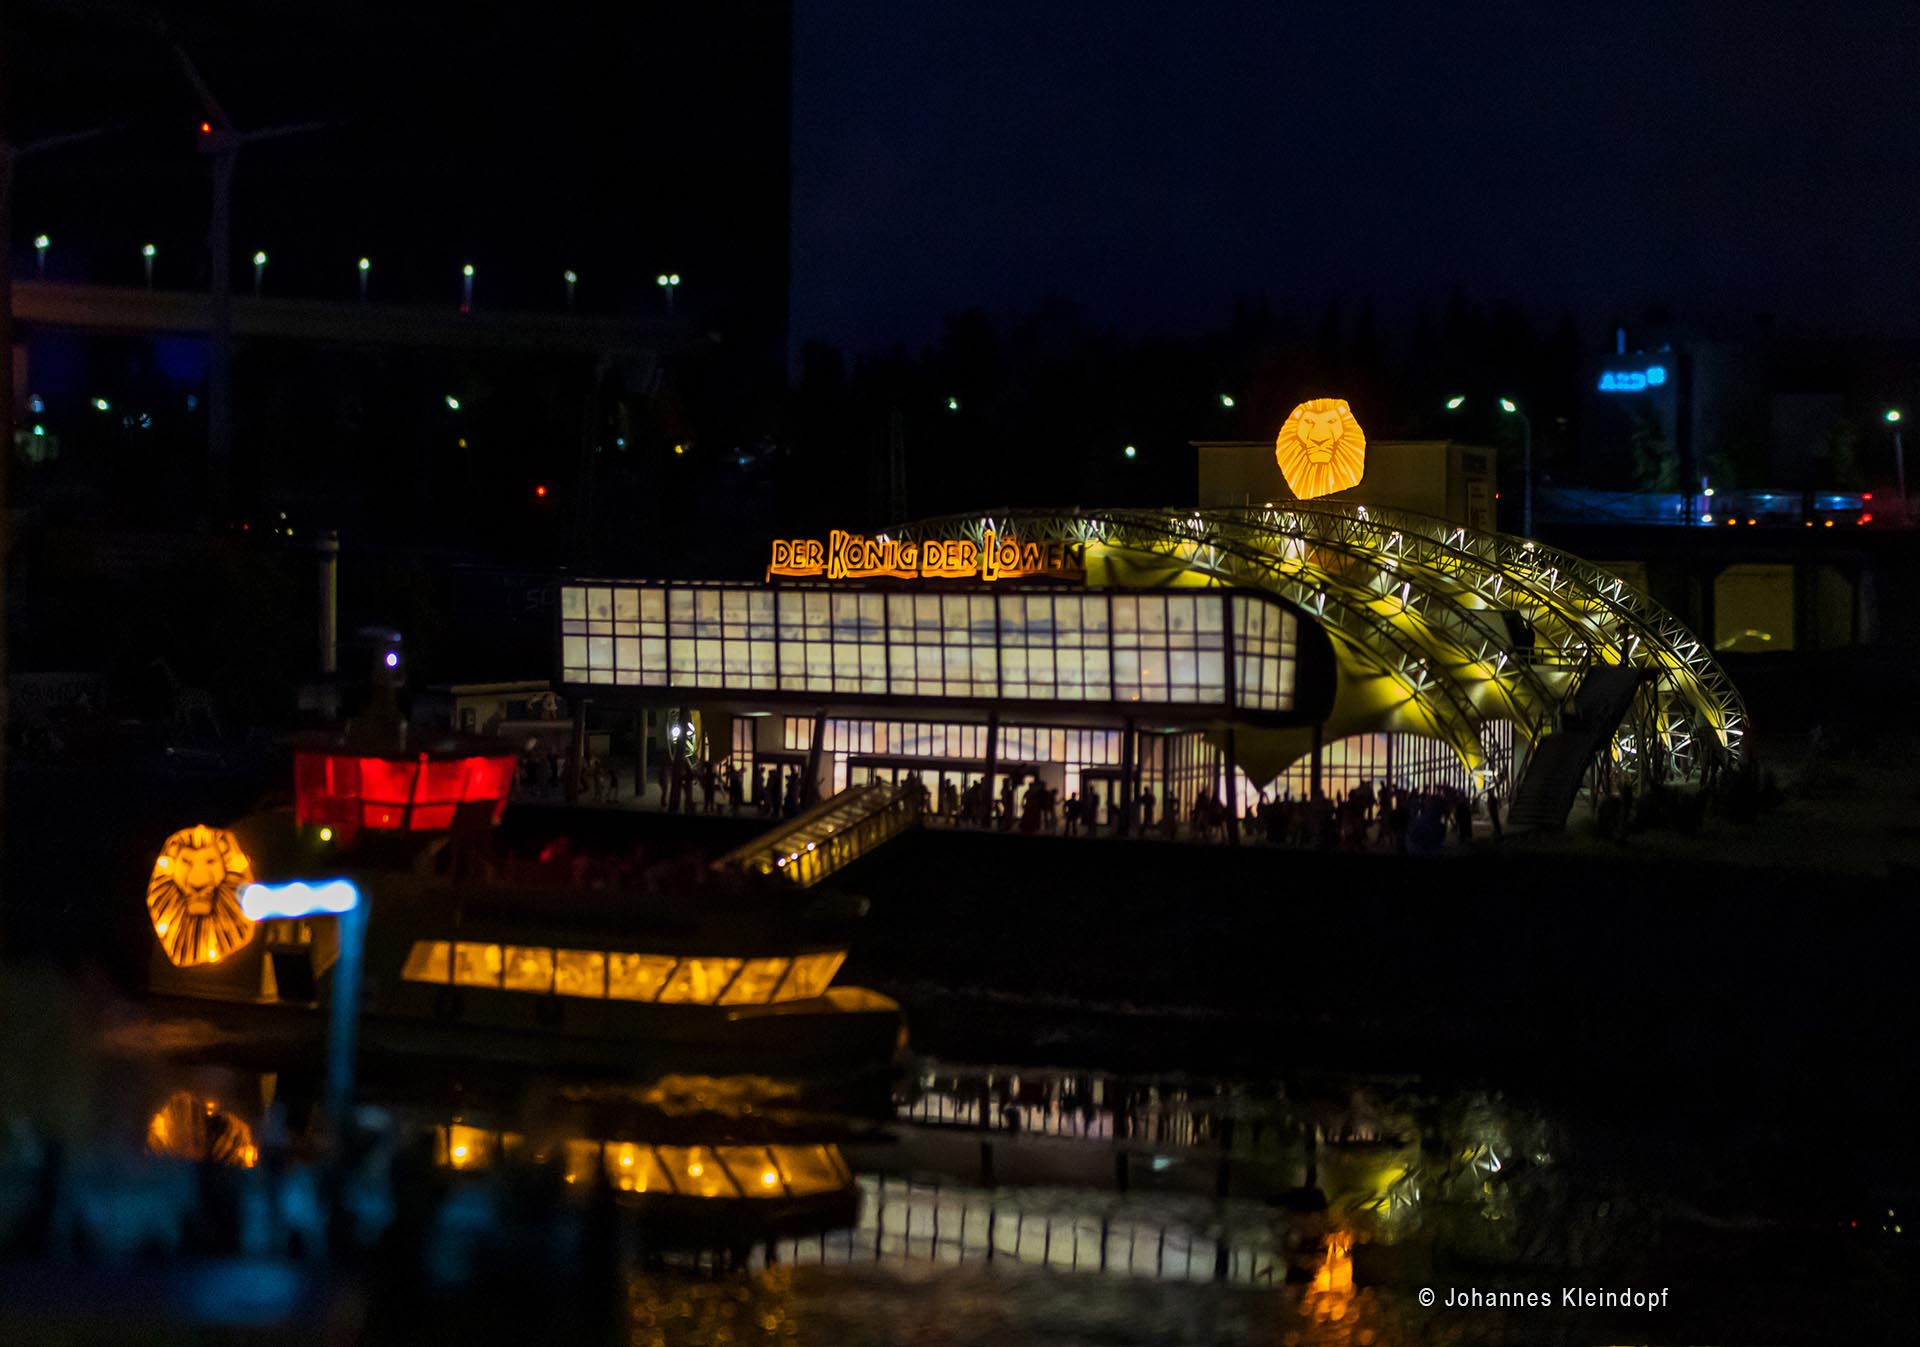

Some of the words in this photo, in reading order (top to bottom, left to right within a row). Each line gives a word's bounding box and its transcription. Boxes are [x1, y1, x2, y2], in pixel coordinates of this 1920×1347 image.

[771, 539, 824, 569] DER
[827, 530, 918, 579] KÖNIG
[922, 539, 977, 570] DER
[982, 529, 1086, 581] LÖWEN
